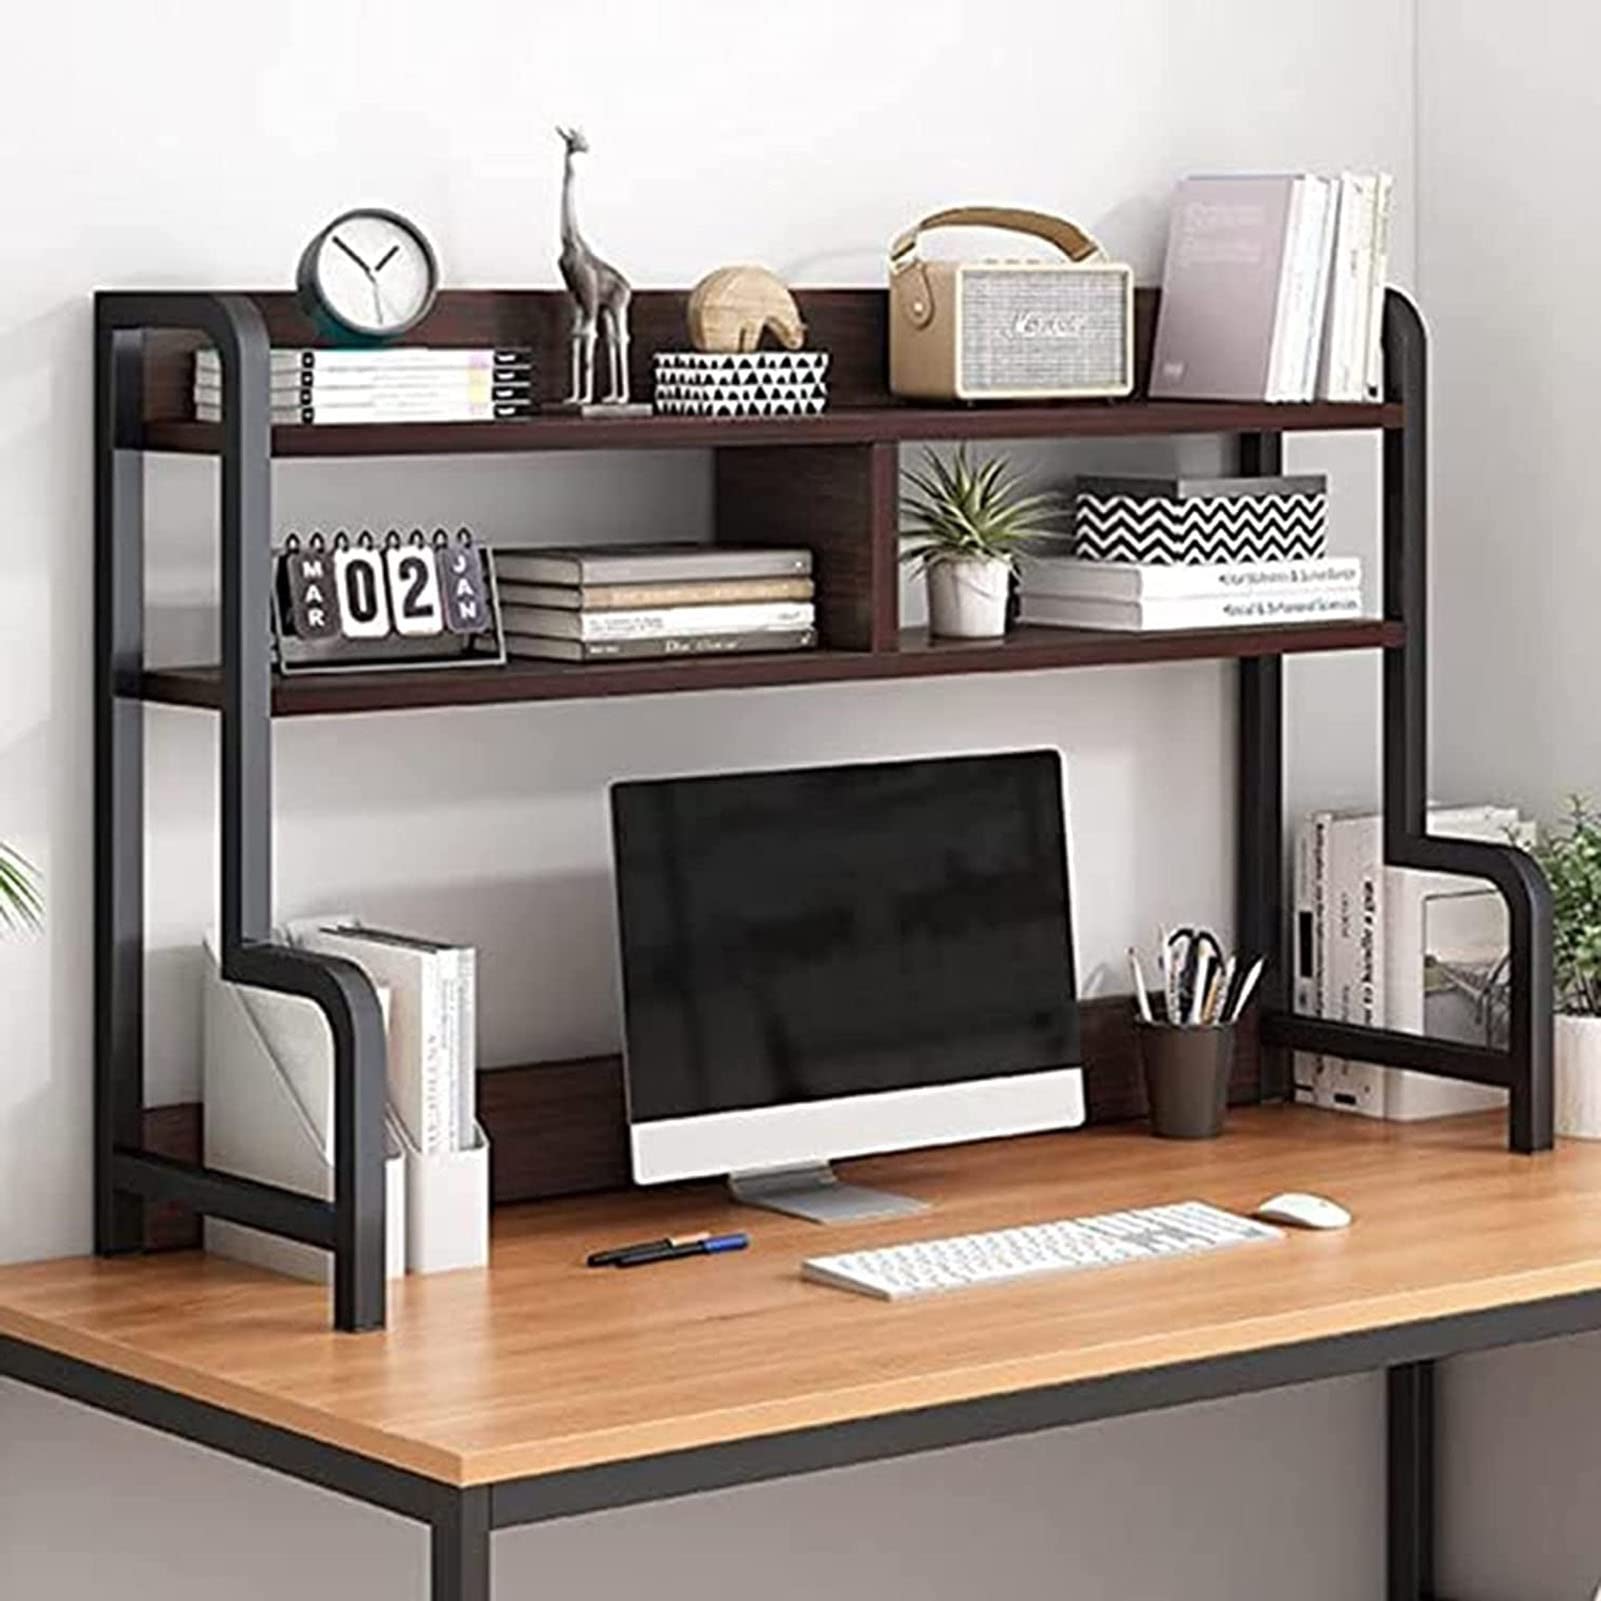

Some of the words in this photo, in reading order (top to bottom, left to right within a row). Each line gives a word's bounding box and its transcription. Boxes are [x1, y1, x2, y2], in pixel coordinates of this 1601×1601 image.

[303, 560, 325, 627] MAR
[345, 556, 434, 623] 02
[453, 555, 477, 619] JAN
